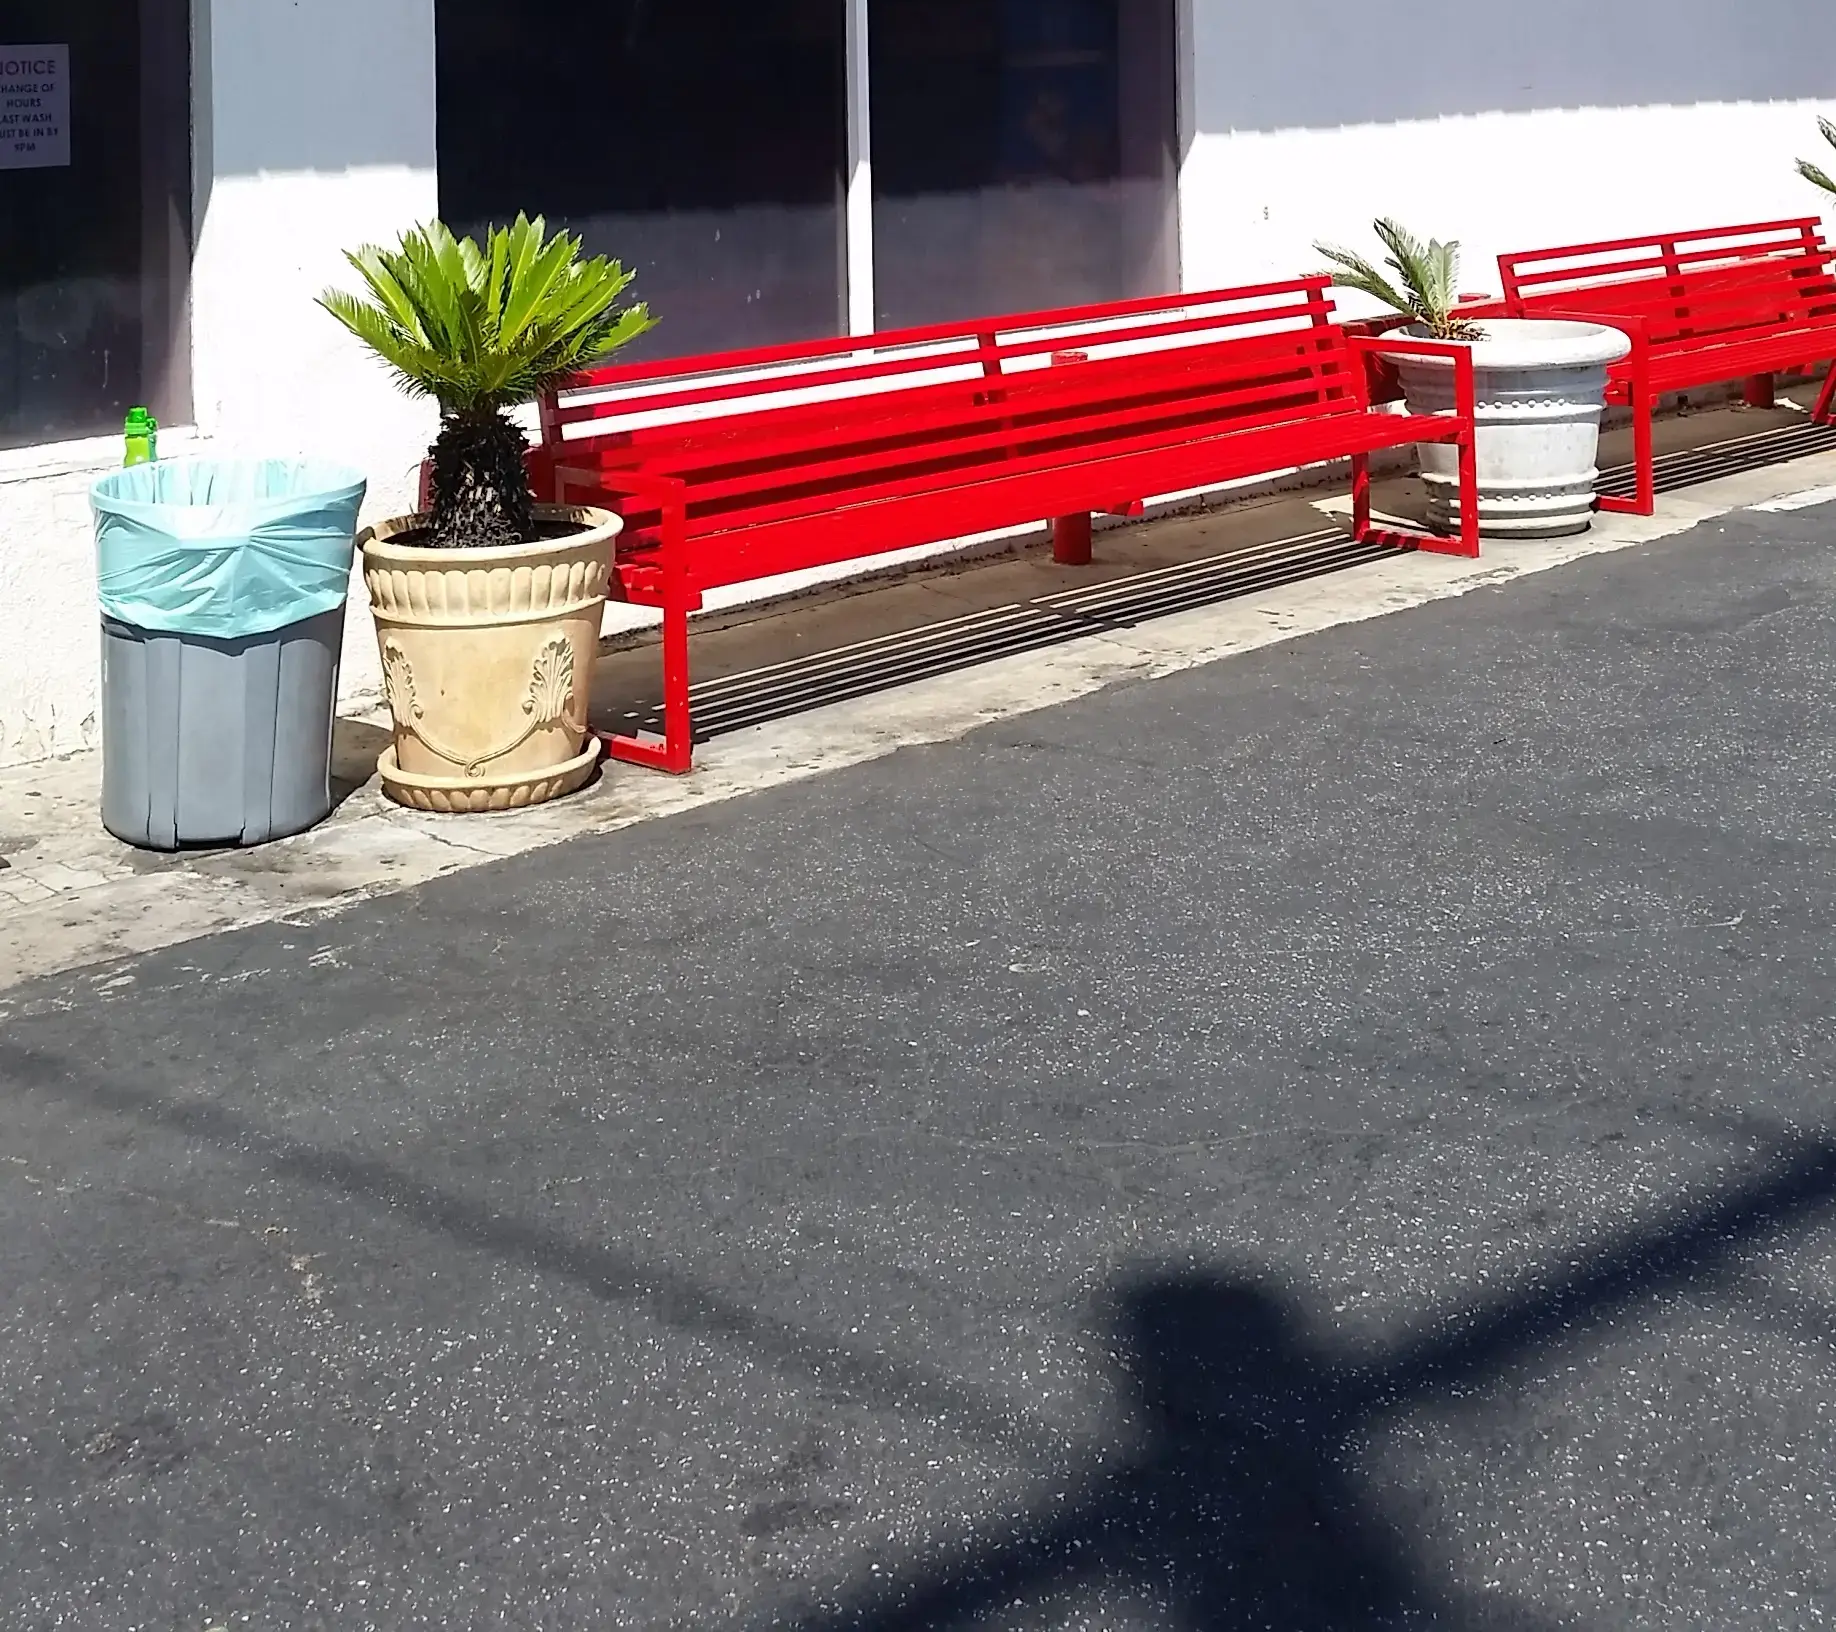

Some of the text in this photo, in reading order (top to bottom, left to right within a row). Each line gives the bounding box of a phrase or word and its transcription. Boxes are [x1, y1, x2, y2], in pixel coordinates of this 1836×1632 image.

[0, 59, 56, 76] OTICE
[0, 83, 39, 94] HANGE
[6, 98, 42, 109] HOURS
[0, 112, 52, 125] AST WASH
[0, 128, 15, 139] UST
[33, 127, 45, 137] IN
